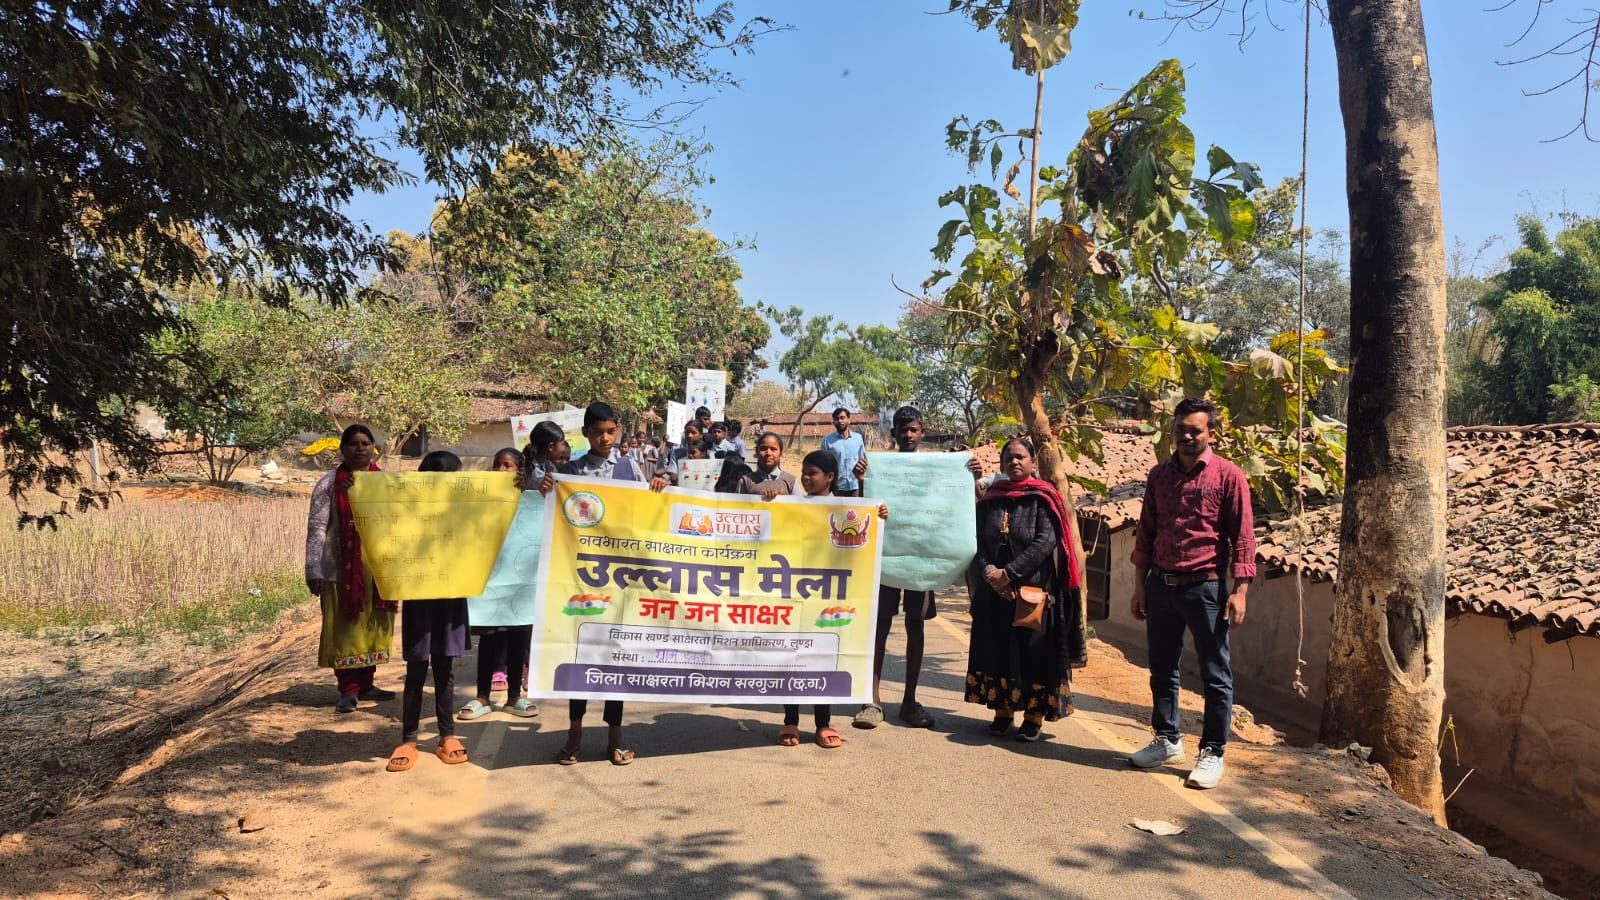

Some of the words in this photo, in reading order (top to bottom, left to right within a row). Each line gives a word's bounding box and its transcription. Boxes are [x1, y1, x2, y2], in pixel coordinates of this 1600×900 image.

[716, 524, 761, 535] ULLAS
[578, 534, 642, 551] नवभारत
[644, 540, 698, 557] साक्षरता
[701, 544, 758, 561] कार्यक्रम
[576, 552, 744, 598] उल्लास
[757, 553, 852, 600] मेला
[638, 597, 679, 620] जन
[684, 601, 722, 624] जन
[726, 602, 794, 626] साक्षर
[608, 628, 642, 641] विकास
[645, 633, 669, 643] खण्ड
[672, 634, 711, 645] साक्षरता
[713, 634, 739, 647] मिशन
[741, 636, 787, 649] प्राधिकरण,
[611, 650, 639, 663] संस्था
[584, 667, 624, 686] जिला
[627, 673, 686, 689] साक्षरता
[688, 672, 732, 690] मिशन
[735, 677, 785, 694] सरगुजा
[787, 676, 828, 693] (छ.ग.)
